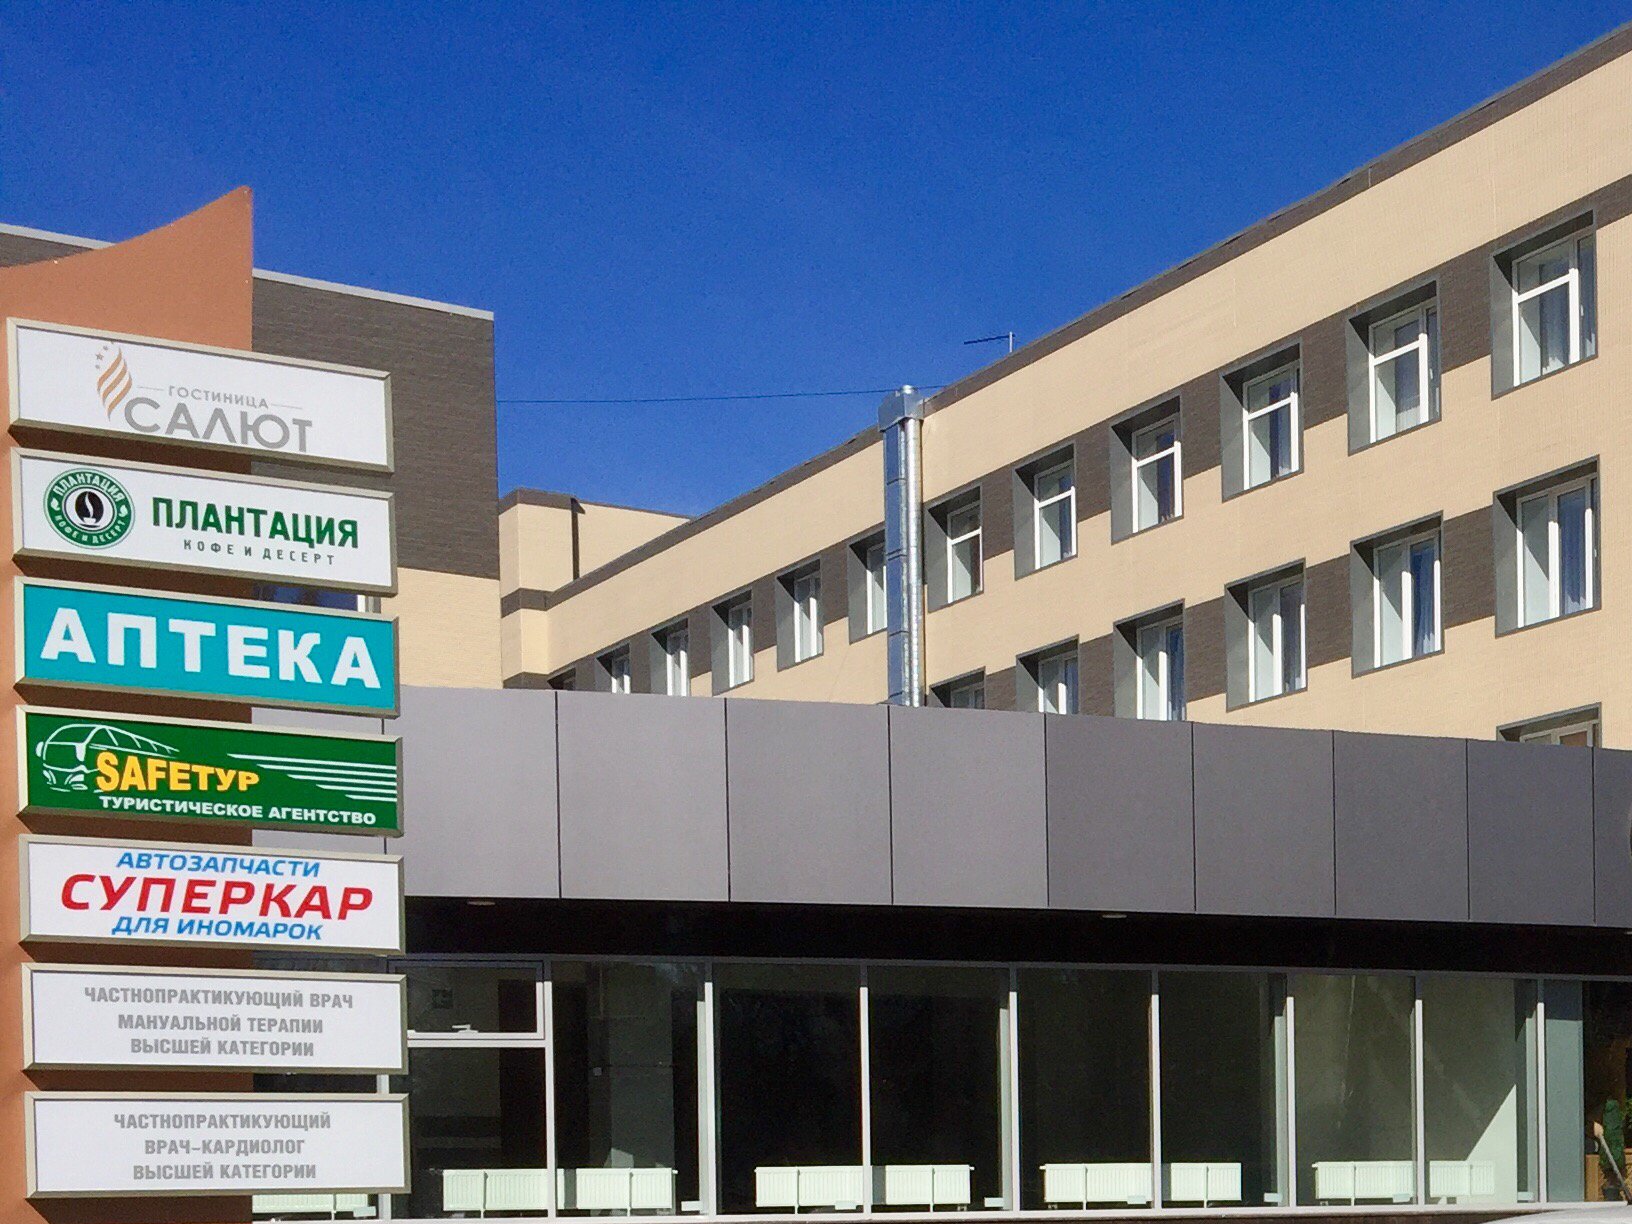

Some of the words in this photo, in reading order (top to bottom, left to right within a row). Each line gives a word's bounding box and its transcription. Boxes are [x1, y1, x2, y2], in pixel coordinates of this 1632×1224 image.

[168, 385, 269, 410] ГОСТИНИЦА
[124, 397, 312, 452] САЛЮТ
[53, 473, 125, 502] ПЛАНТАЦИЯ
[152, 496, 359, 549] ПЛАНТАЦИЯ
[183, 539, 234, 555] КОФЕ
[244, 546, 252, 557] И
[262, 548, 335, 566] ДЕСЕРТ
[40, 607, 381, 689] АПТЕКА
[99, 796, 263, 819] ТУРИСТИЧЕСКОЕ
[268, 807, 377, 825] АГЕНТСТВО
[116, 852, 321, 878] АВТОЗАПЧАСТИ
[61, 874, 374, 921] СУПЕРКАР
[112, 916, 170, 936] ДЛЯ
[176, 919, 324, 940] ИНОМАРОК
[84, 986, 303, 1010] ЧАСТНОПРАКТИКУЮЩИЙ
[310, 993, 354, 1009] ВРАЧ
[118, 1013, 241, 1033] МАНУАЛЬНОЙ
[247, 1017, 324, 1034] ТЕРАПИИ
[130, 1037, 211, 1055] ВЫСШЕЙ
[218, 1040, 315, 1057] КАТЕГОРИИ
[113, 1111, 331, 1132] ЧАСТНОПРАКТИКУЮЩИЙ
[144, 1139, 306, 1158] ВРАЧ-КАРДИОЛОГ
[133, 1162, 213, 1180] ВЫСШЕЙ
[220, 1164, 317, 1180] КАТЕГОРИИ
